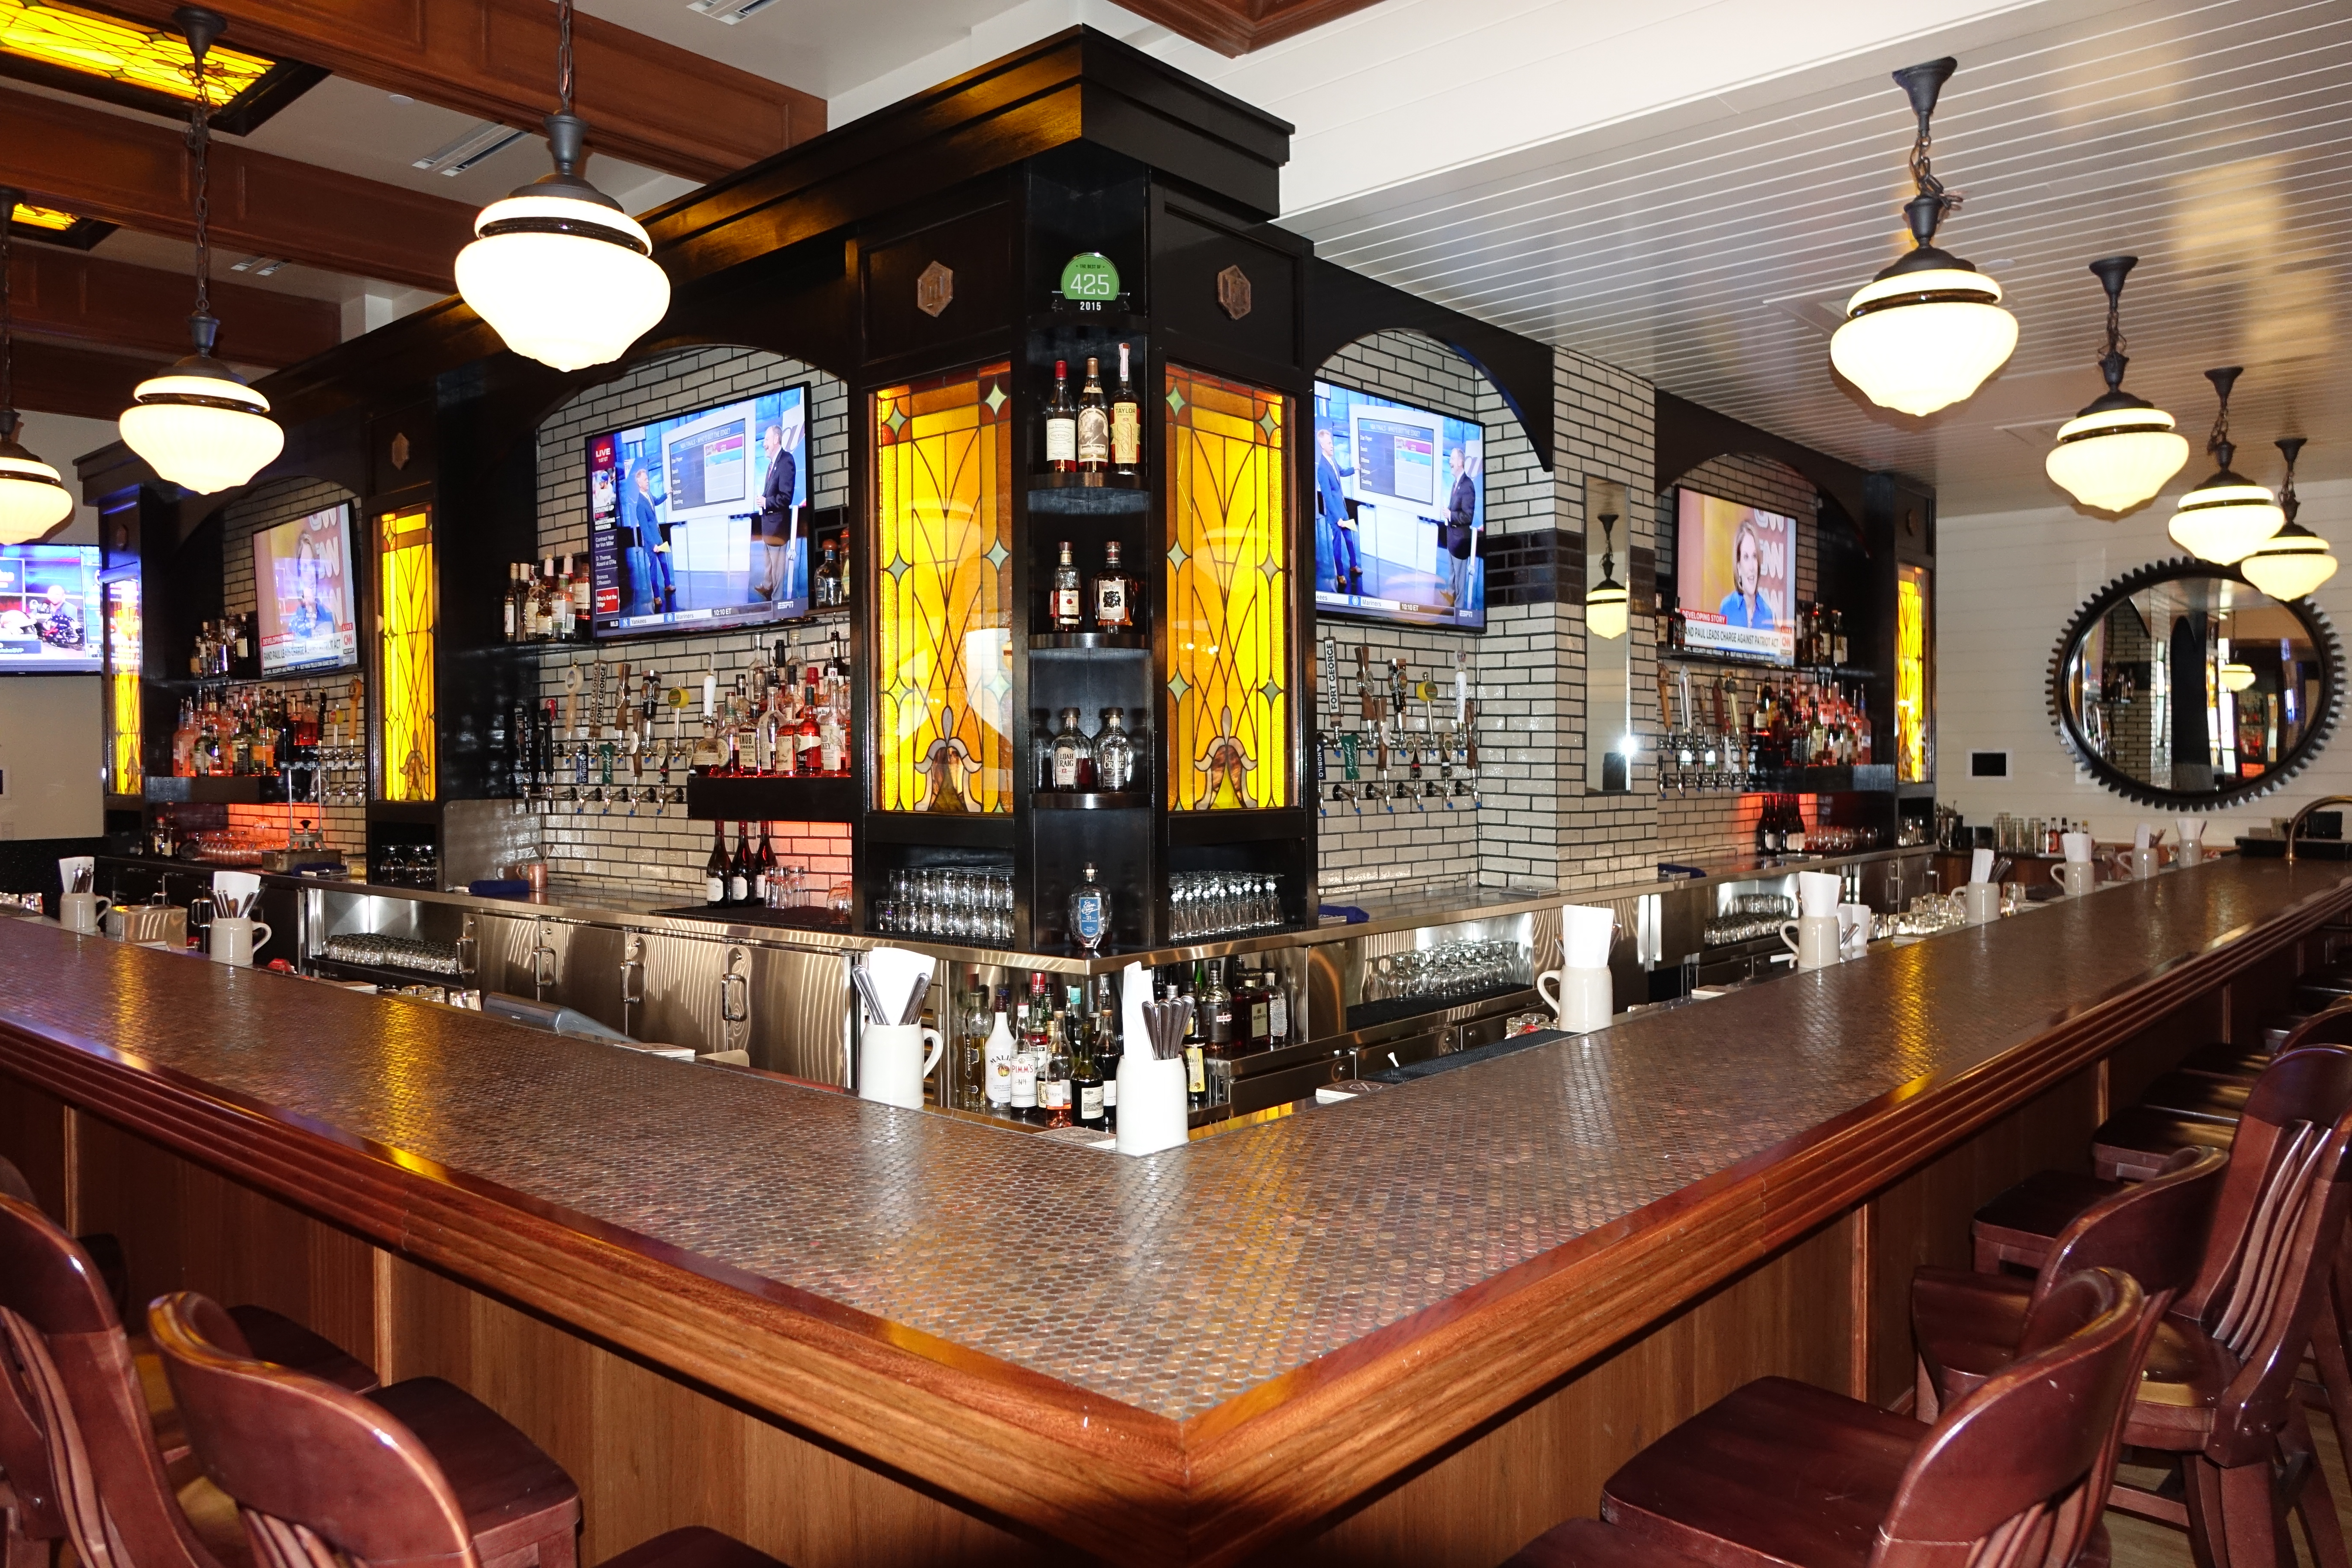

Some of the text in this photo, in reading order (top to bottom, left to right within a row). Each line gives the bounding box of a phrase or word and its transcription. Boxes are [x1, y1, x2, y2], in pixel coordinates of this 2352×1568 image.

[1071, 274, 1109, 294] 425
[1080, 302, 1101, 310] 2015
[595, 447, 610, 458] LIVE
[1754, 508, 1784, 533] CNN
[315, 536, 340, 580] NN
[778, 601, 794, 609] ESPN
[1362, 599, 1381, 607] Mariners
[1682, 610, 1725, 623] DEVELOPING STORY
[263, 636, 282, 645] DEVELOPING
[344, 634, 352, 645] CNN
[1685, 626, 1694, 637] AND
[1695, 628, 1705, 638] PAUL
[1706, 630, 1719, 640] LEADS
[1720, 632, 1736, 642] CHARGE
[1737, 634, 1754, 644] AGAINST
[1755, 637, 1770, 646] PATRIOT
[1782, 637, 1791, 647] CNN
[1326, 643, 1336, 681] GEORGE
[739, 735, 752, 744] KNOB
[1342, 743, 1353, 775] Acrobat
[602, 750, 611, 780] Acrobat
[989, 1055, 1011, 1066] MALI
[1012, 1064, 1033, 1073] PIMM'S
